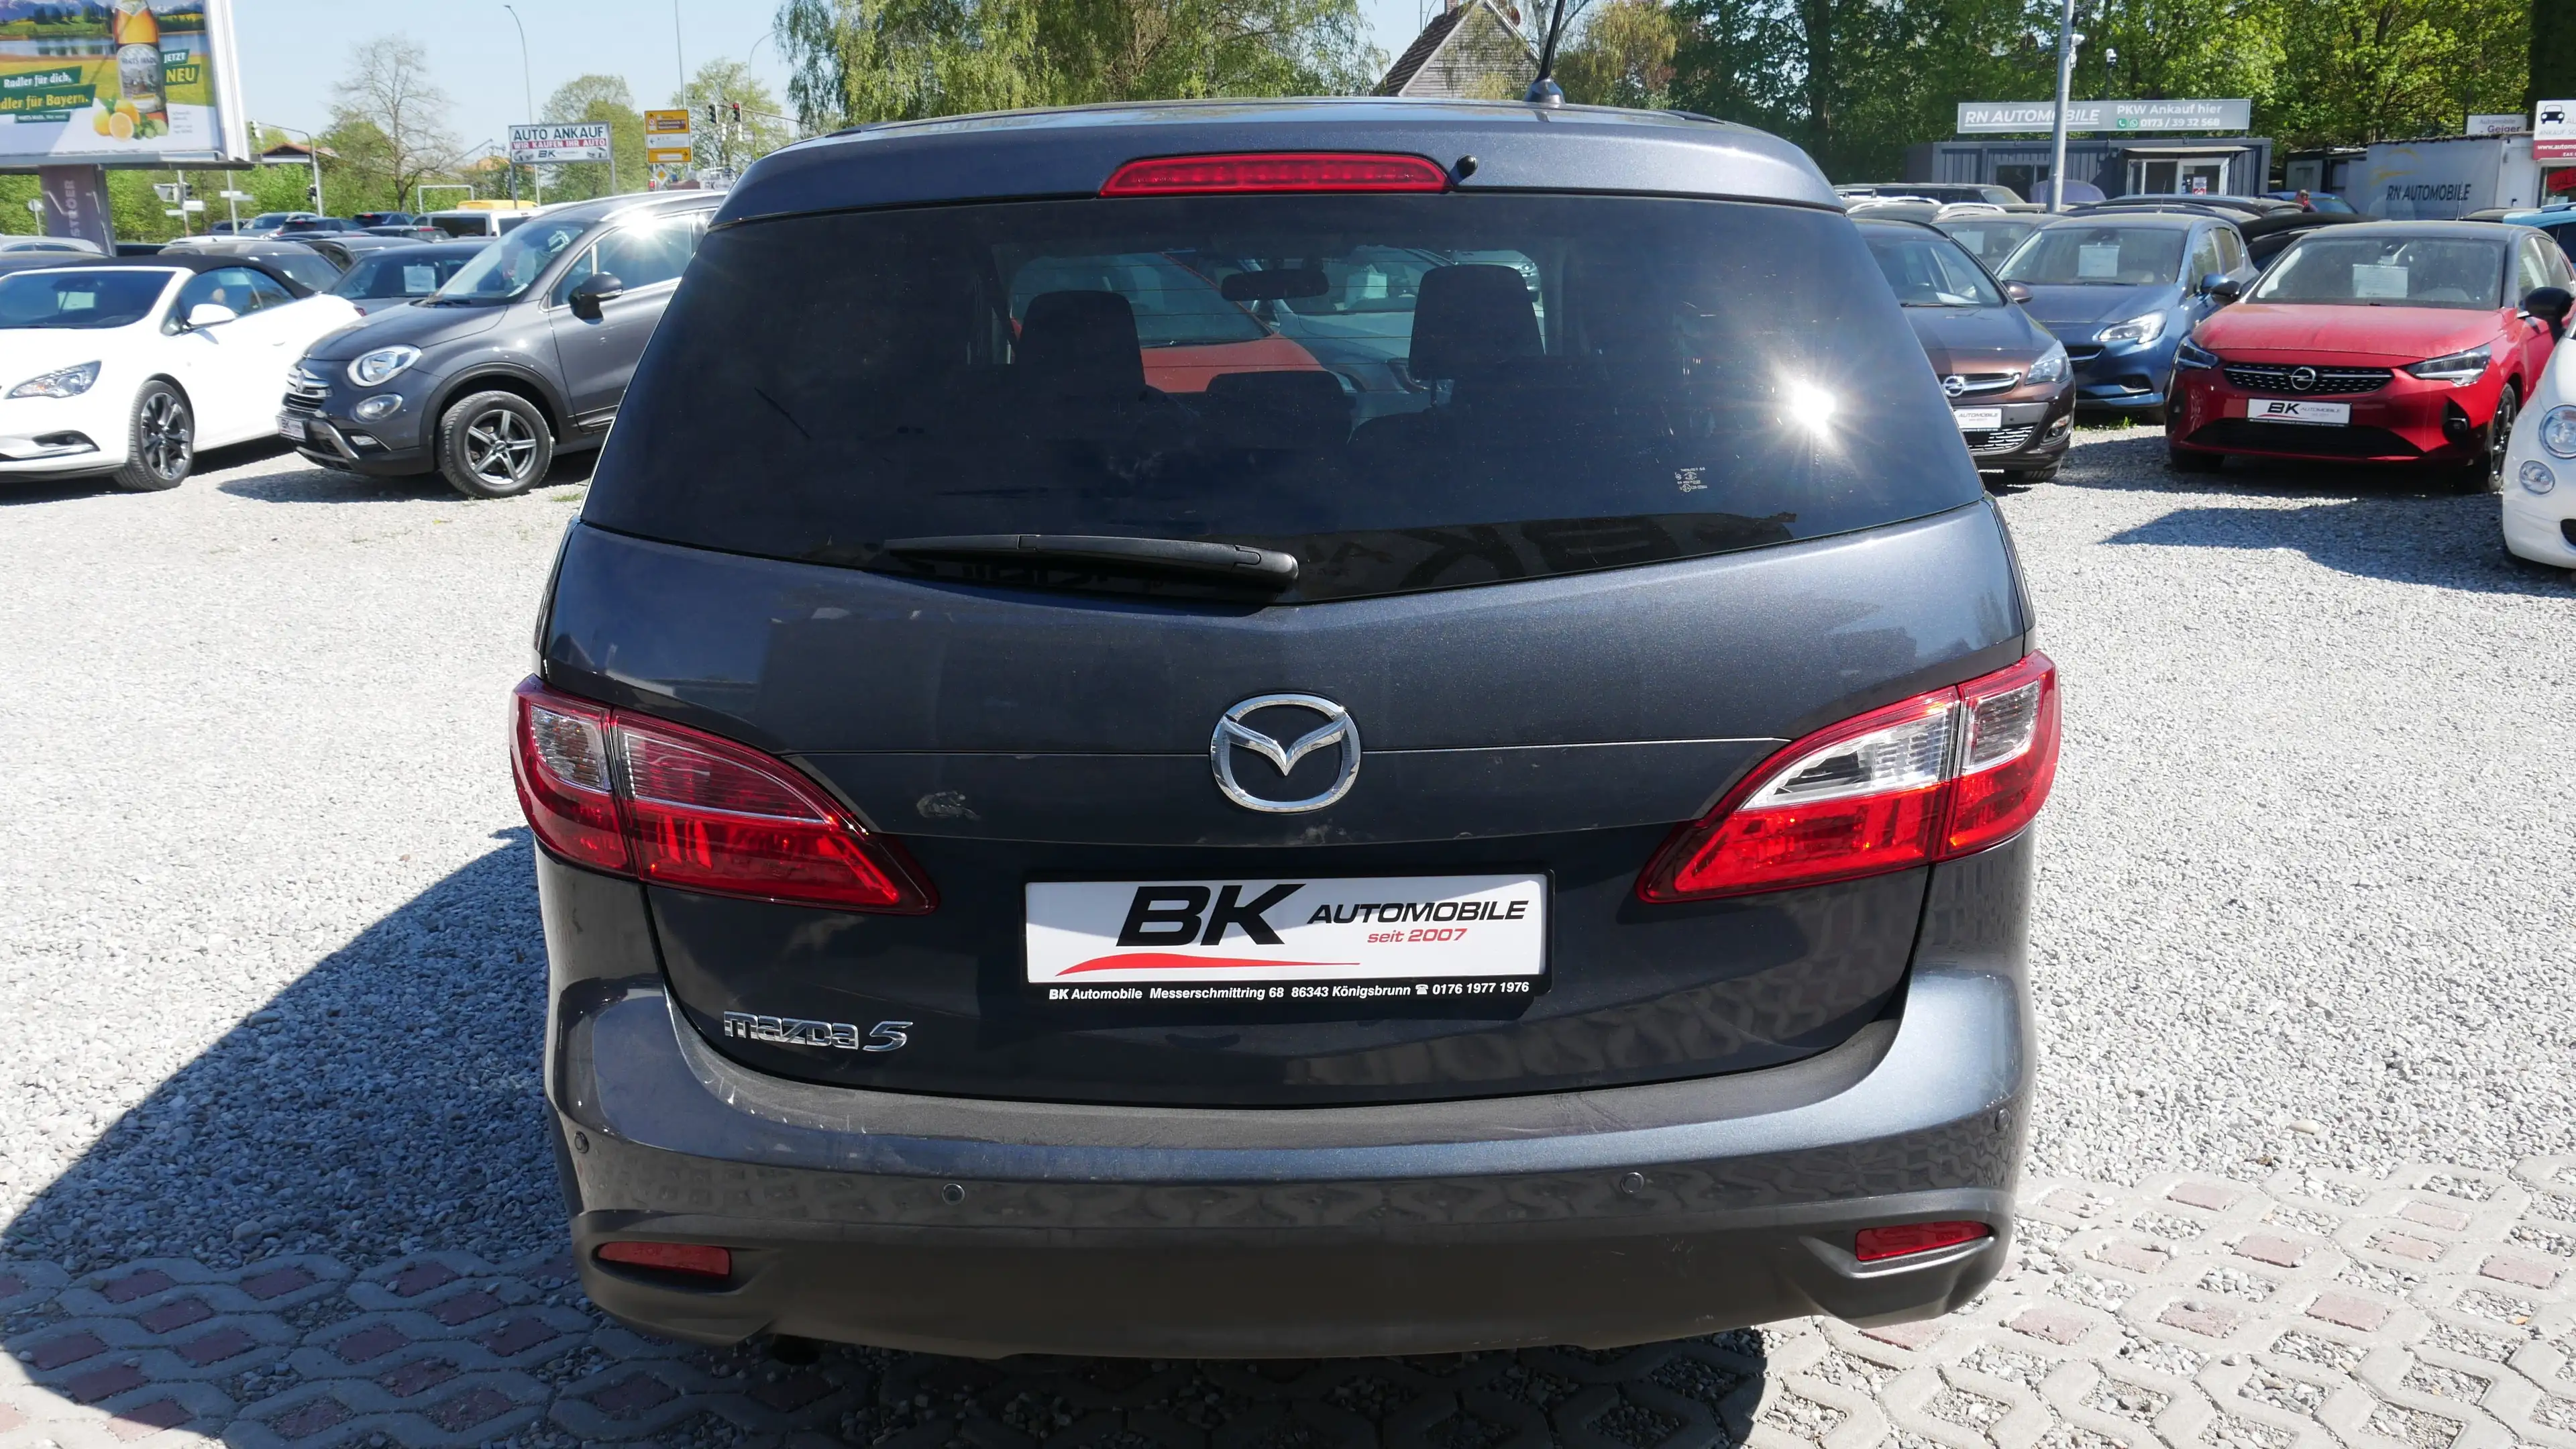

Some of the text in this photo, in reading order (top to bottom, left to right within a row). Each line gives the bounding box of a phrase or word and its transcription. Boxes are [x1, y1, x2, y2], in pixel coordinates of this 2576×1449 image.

[164, 52, 186, 63] JETZT
[3, 72, 72, 88] Radler für dich.
[166, 67, 195, 83] NEU
[25, 95, 43, 110] für
[46, 94, 89, 107] Bayern.
[2117, 103, 2222, 115] PKW Ankauf hier
[1965, 109, 2100, 123] RN AUTOMBILE
[2141, 118, 2163, 127] 0173
[2171, 118, 2185, 127] 39
[2187, 118, 2200, 126] 32
[513, 126, 603, 141] AUTO ANKAUF
[2487, 125, 2521, 133] Geiger
[513, 141, 529, 150] WIR
[532, 140, 563, 148] KAUFEN
[583, 139, 605, 147] AUTO
[538, 150, 555, 158] BK
[2386, 183, 2471, 201] RN AUTOMOBILE
[2267, 402, 2300, 414] BK
[1115, 883, 1529, 947] BK AUTOMOBILE
[1366, 928, 1468, 944] seit 2007
[1049, 981, 1529, 1000] BK Automobile Messerschmittring 68 86343 Königsbrunn 0176 1977 1976
[863, 1020, 914, 1052] 5
